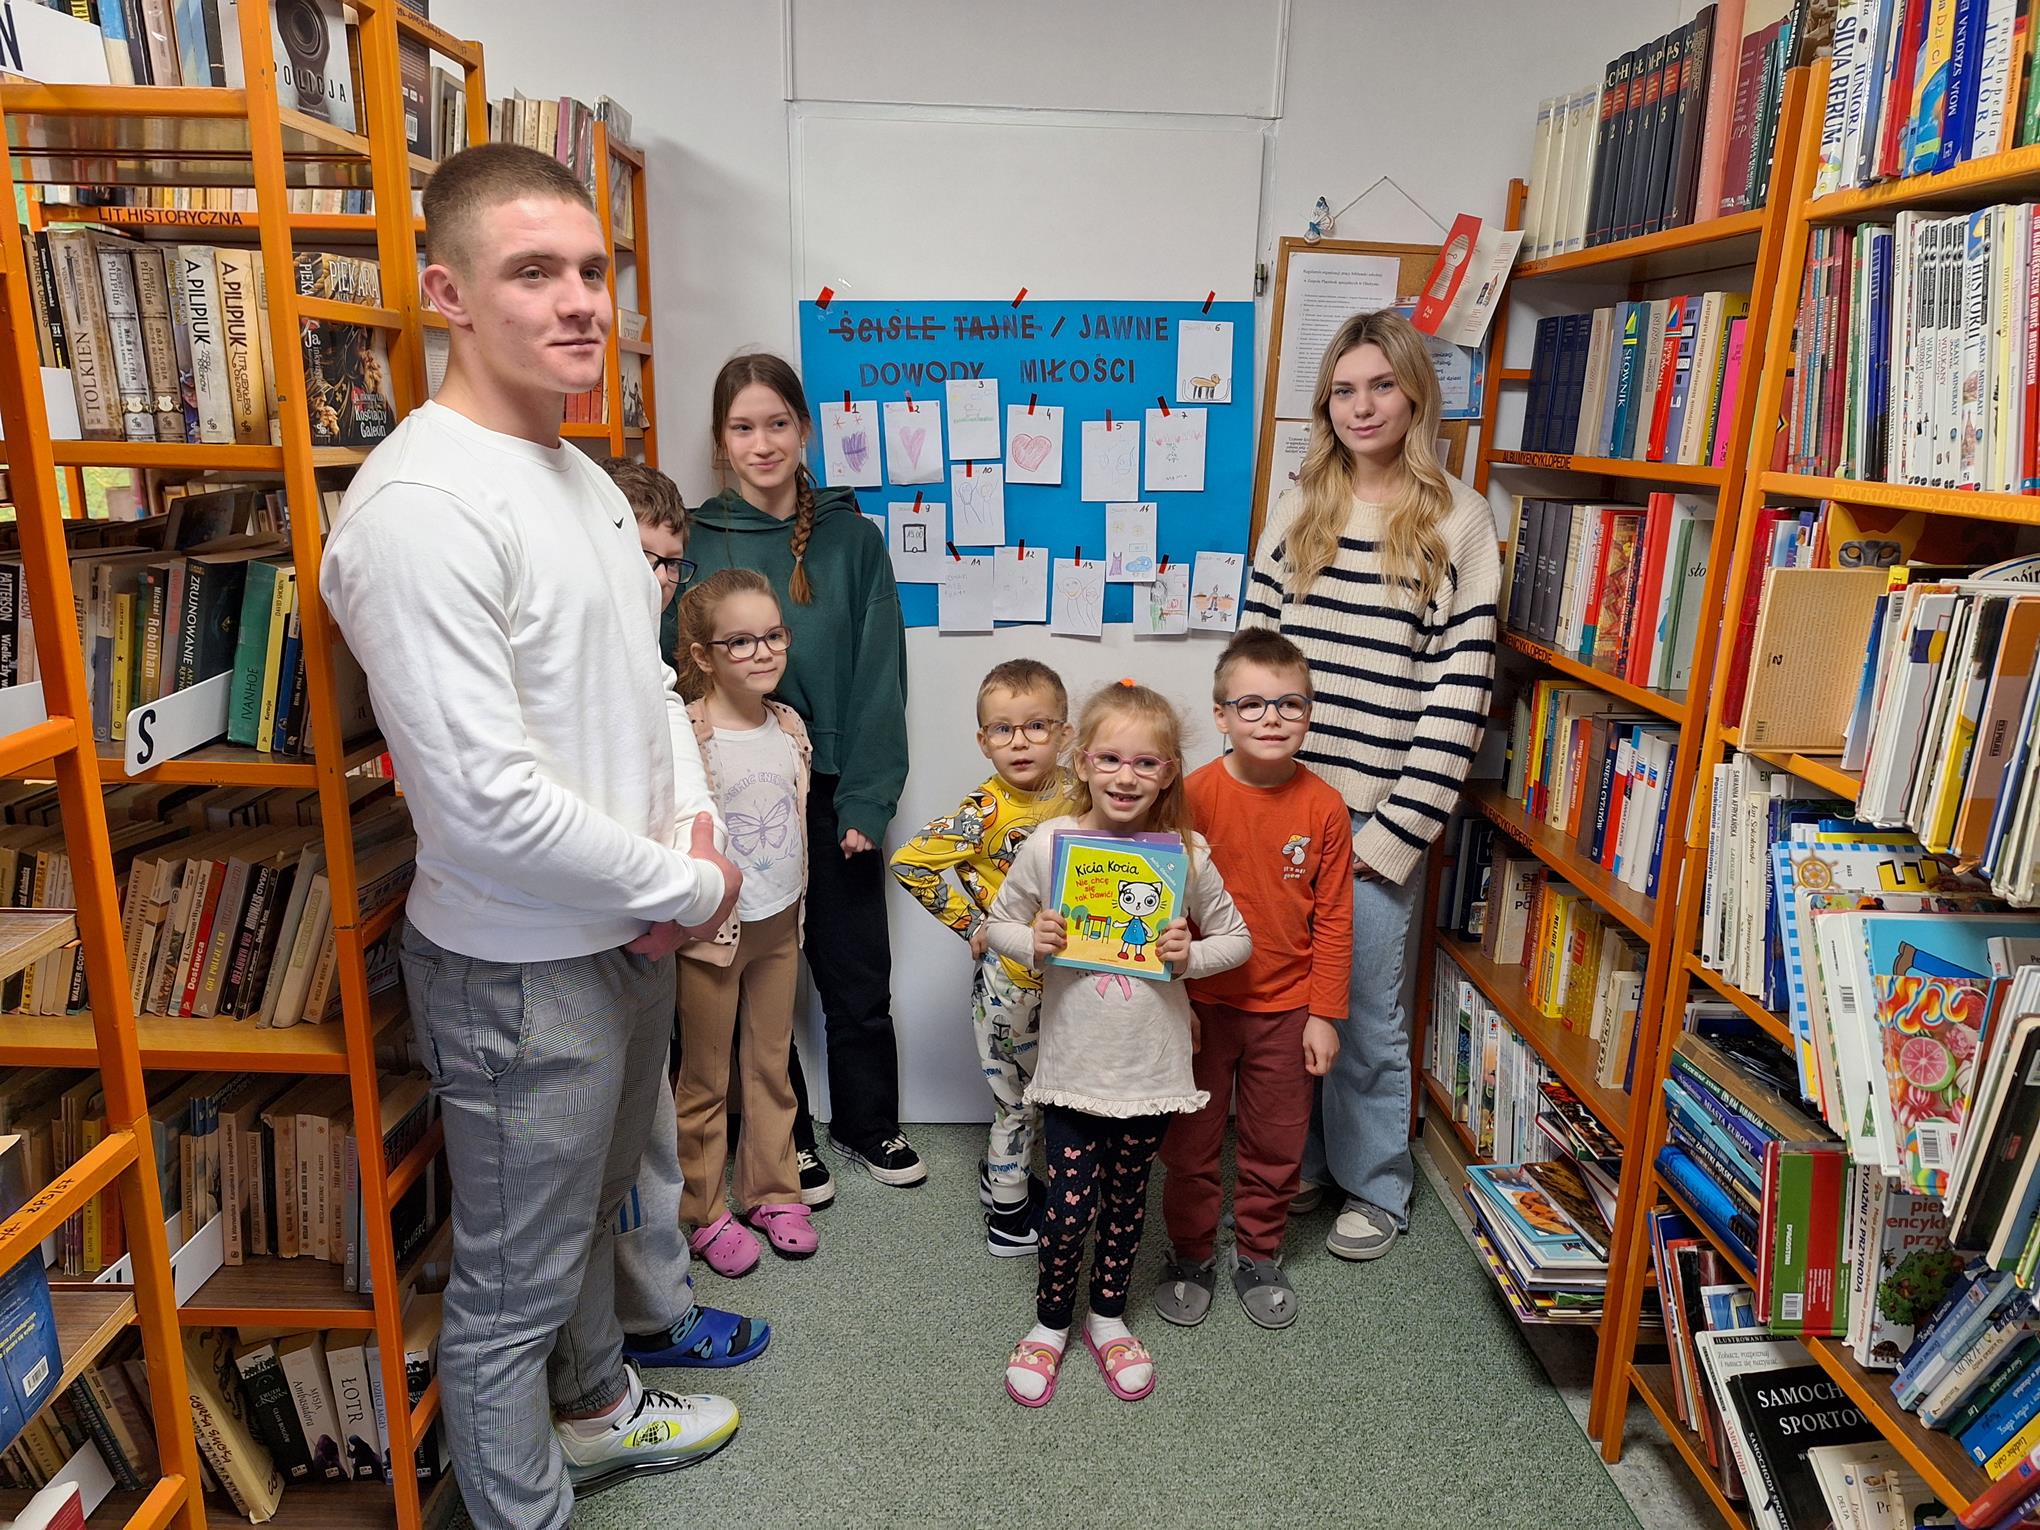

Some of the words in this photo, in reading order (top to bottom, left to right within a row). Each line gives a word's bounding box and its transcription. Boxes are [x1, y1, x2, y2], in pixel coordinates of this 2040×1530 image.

[1831, 16, 1857, 72] SILVA
[1952, 16, 1970, 76] SZKOLNA
[1975, 22, 1999, 142] JUNIORA
[1988, 17, 2011, 138] encyklopedia
[1660, 106, 1668, 124] 5
[1679, 97, 1687, 115] 6
[1821, 73, 1850, 147] RERUM
[1847, 62, 1867, 137] JUNIORA
[1948, 80, 1961, 117] MOJA
[1627, 118, 1634, 136] 3
[2031, 231, 2040, 295] NAJWIĘKSZYCH
[1968, 264, 1984, 339] HISTORII
[2029, 296, 2039, 329] ODKRYĆ
[953, 315, 1036, 341] TAJNE
[1079, 314, 1168, 341] JAWNE
[1664, 341, 1675, 367] NOWY
[1925, 337, 1934, 370] WRAKI
[1939, 336, 1948, 387] WULKANY
[1952, 337, 1961, 366] SKAŁY
[1979, 335, 1987, 363] SKAŁY
[2027, 330, 2037, 386] MEDYCZNYCH
[75, 332, 99, 414] TOLKIEN
[859, 360, 985, 387] DOWODY
[1020, 354, 1135, 384] MIŁOŚCI
[1618, 349, 1633, 408] SŁOWNIK
[1951, 370, 1960, 417] MINERAŁY
[1976, 368, 1986, 417] MINERAŁY
[153, 586, 162, 616] Michael
[182, 575, 201, 666] ZRUJNOWANIE
[145, 617, 161, 678] Robotham
[1508, 634, 1553, 664] ENCYKLOPEDIE
[240, 667, 259, 721] IVANHOE
[136, 709, 156, 765] S
[1600, 758, 1612, 790] KSIĘGA
[1732, 769, 1741, 797] SAWANNA
[1596, 789, 1608, 832] CYTATÓW
[1710, 776, 1720, 829] Poszukiwanie
[1729, 798, 1739, 838] AFRYKAŃSKA
[1749, 802, 1759, 819] Jan
[1489, 810, 1534, 849] ENCYKLOPEDIE
[1075, 861, 1104, 877] Kicia
[1107, 860, 1139, 875] Kocia
[1076, 879, 1088, 888] Nie
[1091, 877, 1110, 886] chcę
[1084, 885, 1096, 893] się
[1075, 893, 1088, 902] tak
[1090, 890, 1113, 901] bawić!
[1704, 882, 1713, 917] światów
[1551, 914, 1561, 949] RELIGIE
[71, 971, 83, 1002] WALTER
[134, 951, 148, 1001] FRANKENSTEIN
[187, 941, 206, 991] Dostawca
[1596, 1007, 1613, 1084] LEKSYKON
[1703, 1098, 1726, 1126] MIASTA
[1726, 1120, 1755, 1152] EUROPY
[1714, 1159, 1734, 1185] POLSKI
[1860, 1165, 1871, 1216] ZYJAŹNI
[1854, 1228, 1868, 1294] PRZYRODĄ
[1715, 1335, 1764, 1345] ILUSTROWANE
[341, 1377, 364, 1424] ŁOTR
[1725, 1420, 1749, 1477] SAMOCHODY
[1748, 1432, 1776, 1495] SAMOCHODY
[2005, 1435, 2028, 1459] Ludzkie
[1837, 1495, 1851, 1521] DELTA
